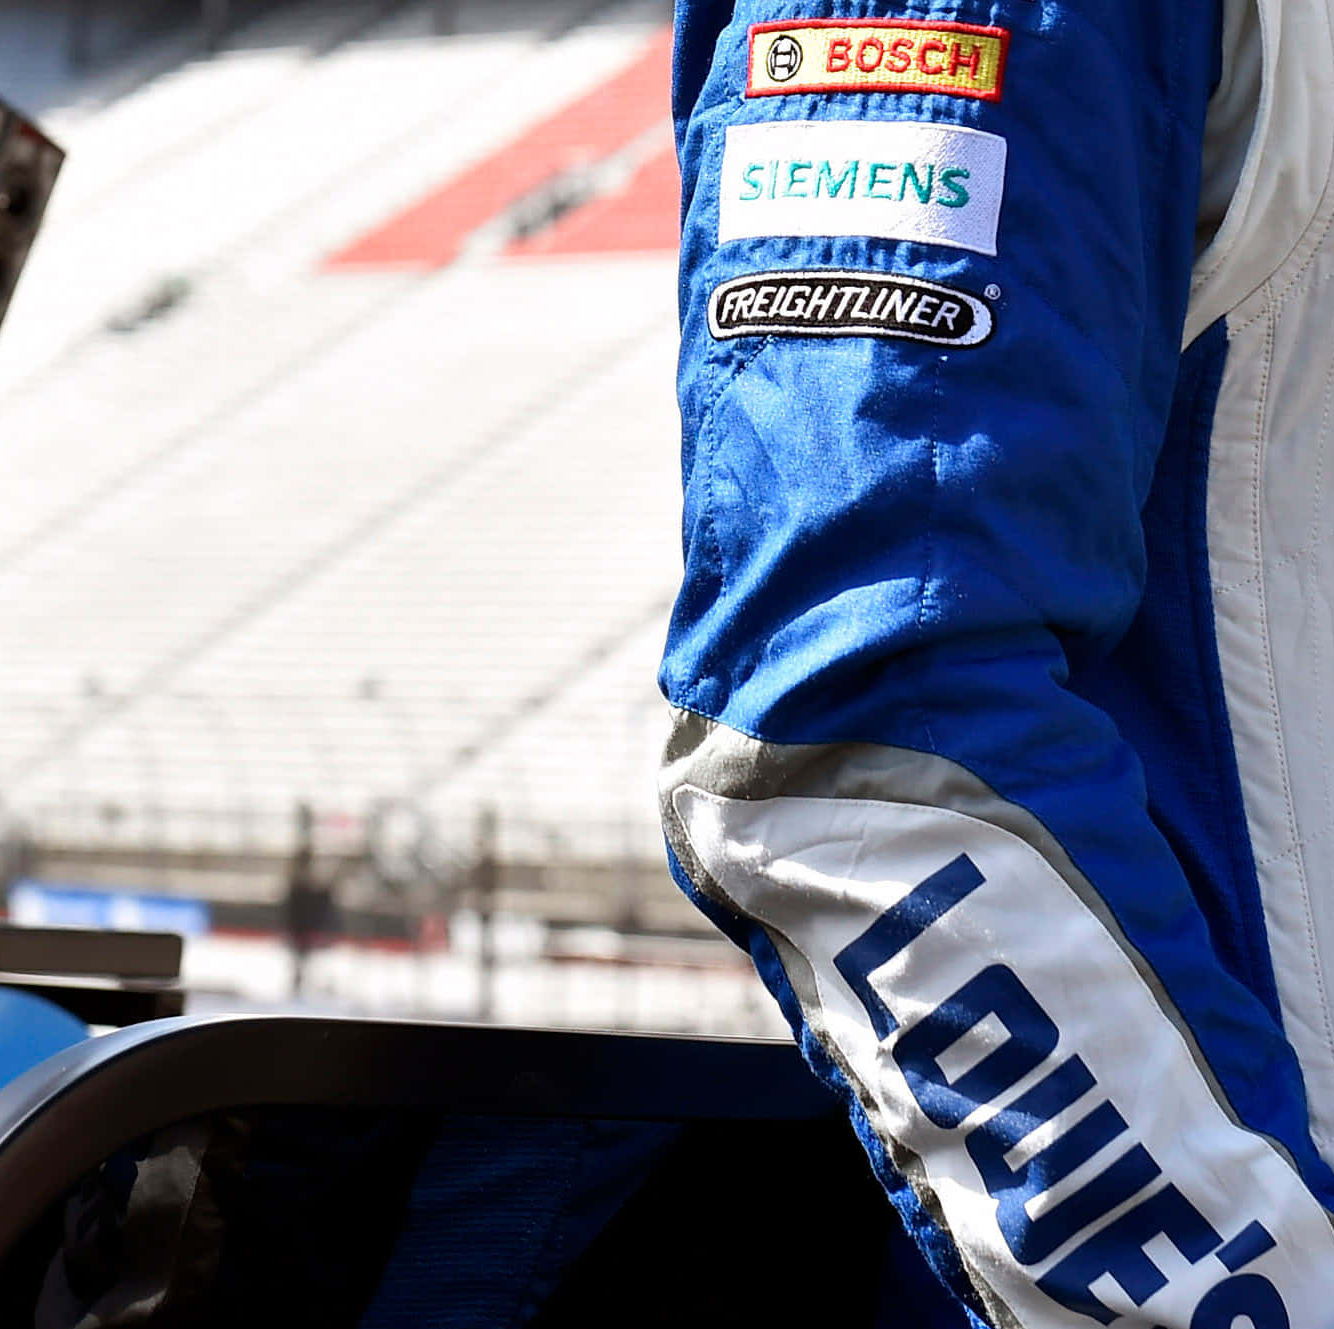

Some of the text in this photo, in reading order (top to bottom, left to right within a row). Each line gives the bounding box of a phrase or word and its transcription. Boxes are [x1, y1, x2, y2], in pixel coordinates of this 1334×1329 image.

[825, 37, 982, 80] BOSCH
[739, 158, 971, 210] SIEMENS
[720, 284, 961, 331] FREIGHTLINER
